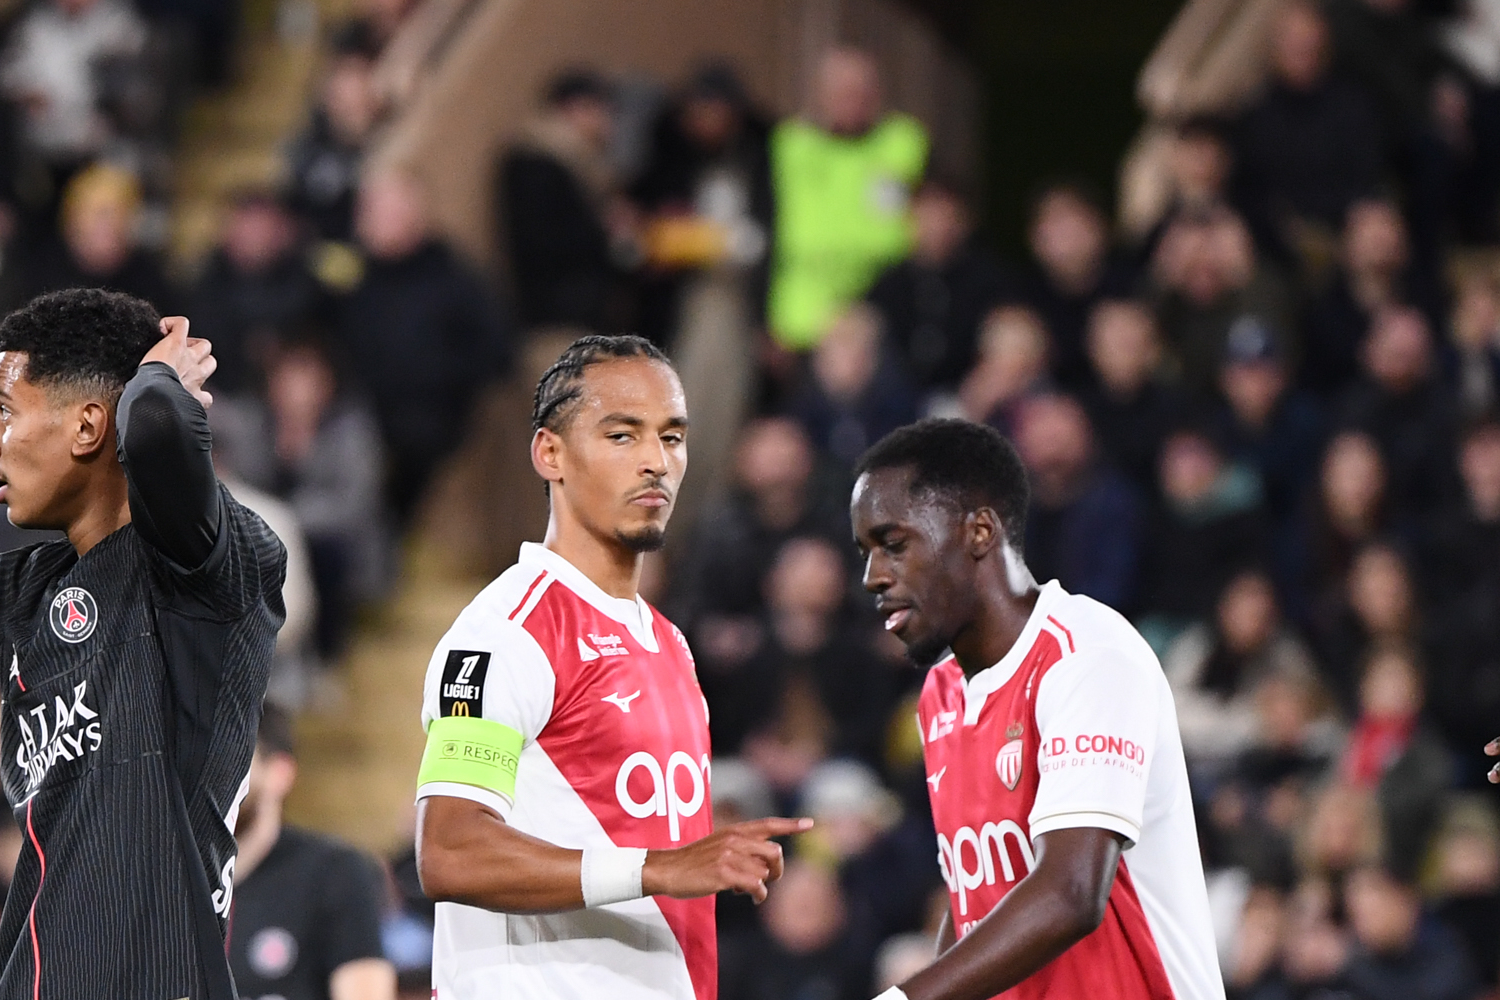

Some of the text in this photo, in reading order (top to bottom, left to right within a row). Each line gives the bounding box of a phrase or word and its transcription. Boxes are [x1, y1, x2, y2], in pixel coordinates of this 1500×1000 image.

[54, 590, 86, 609] PARIS
[1075, 734, 1145, 766] CONGO
[1071, 757, 1087, 768] DE
